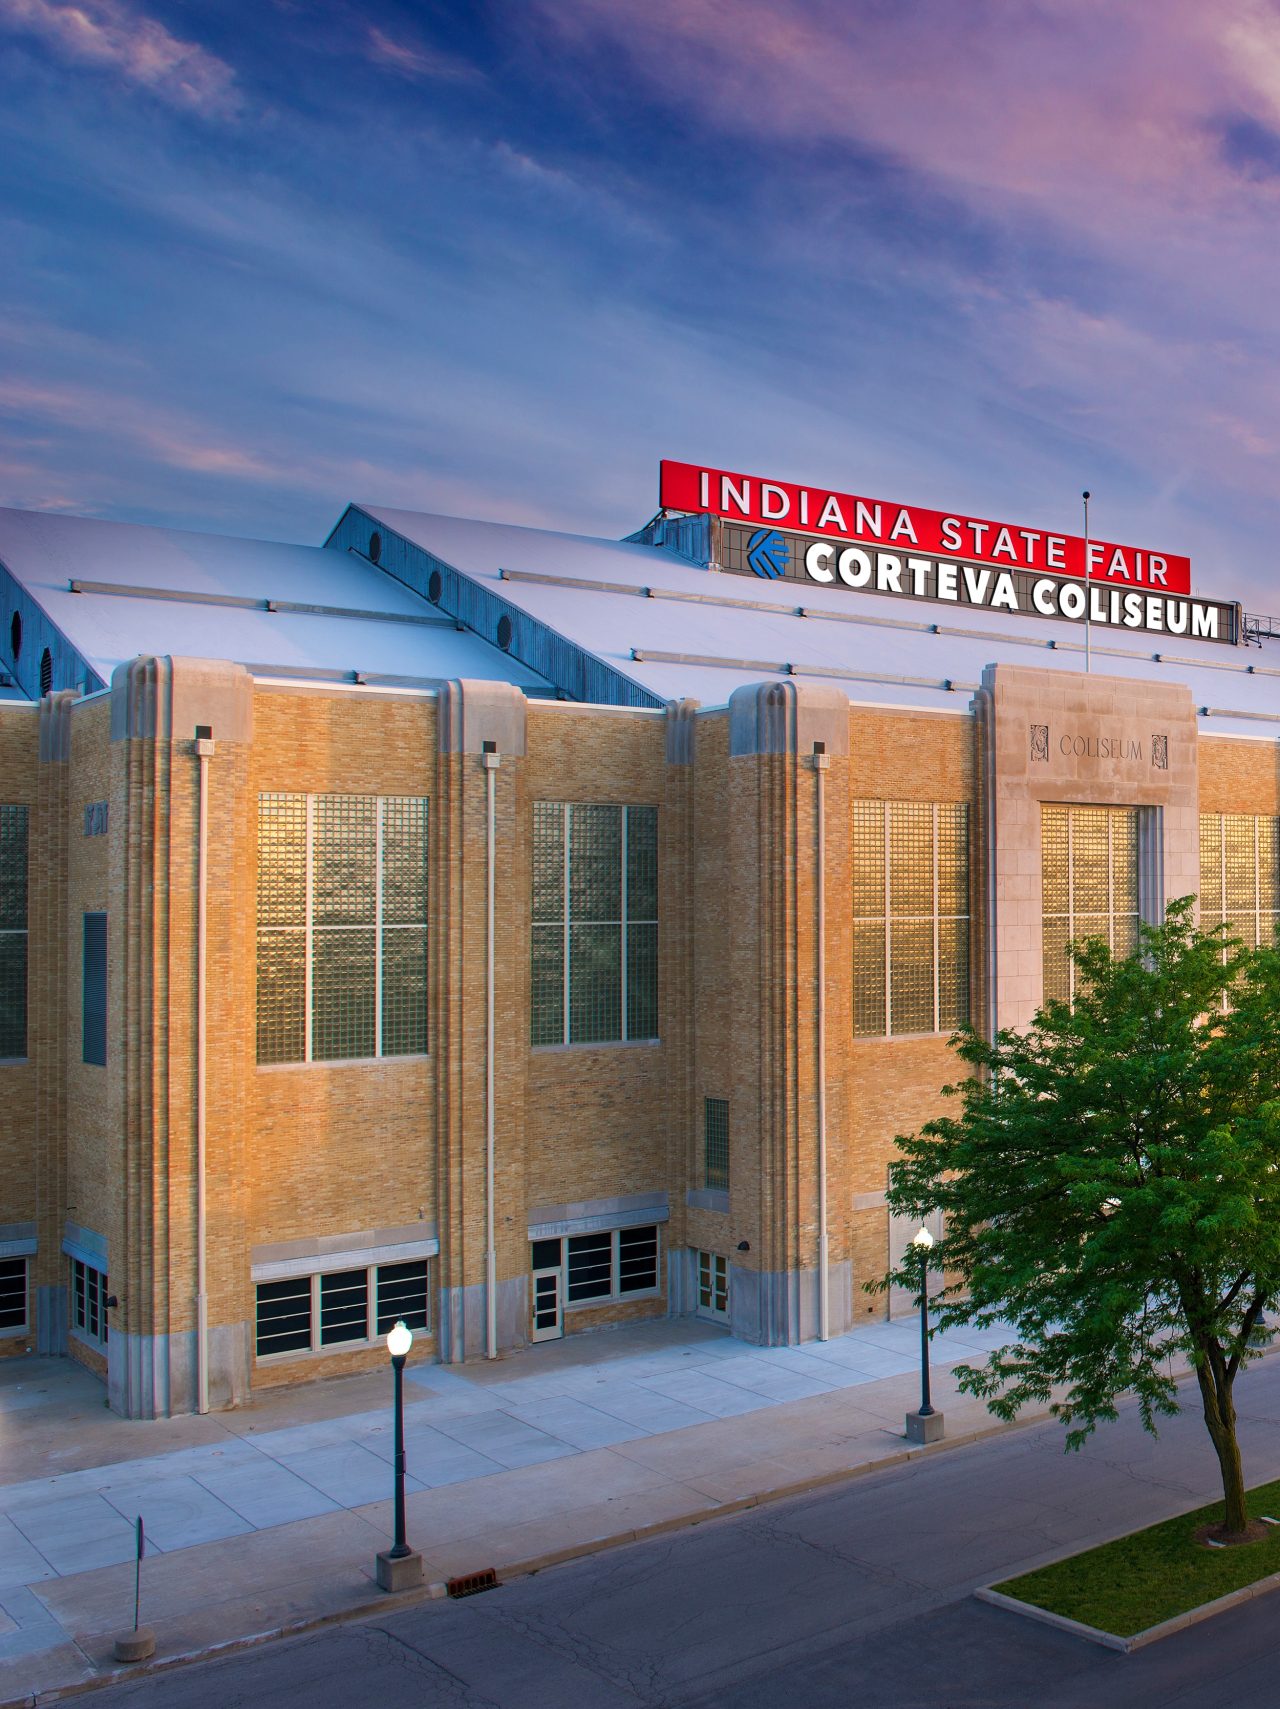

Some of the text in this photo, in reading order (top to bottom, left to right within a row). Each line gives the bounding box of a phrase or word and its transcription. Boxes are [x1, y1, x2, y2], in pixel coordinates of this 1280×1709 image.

[700, 472, 1168, 586] INDIANA STATE FAIR
[805, 543, 1218, 638] CORTEVA COLISEUM
[1059, 734, 1143, 761] COLISEUM
